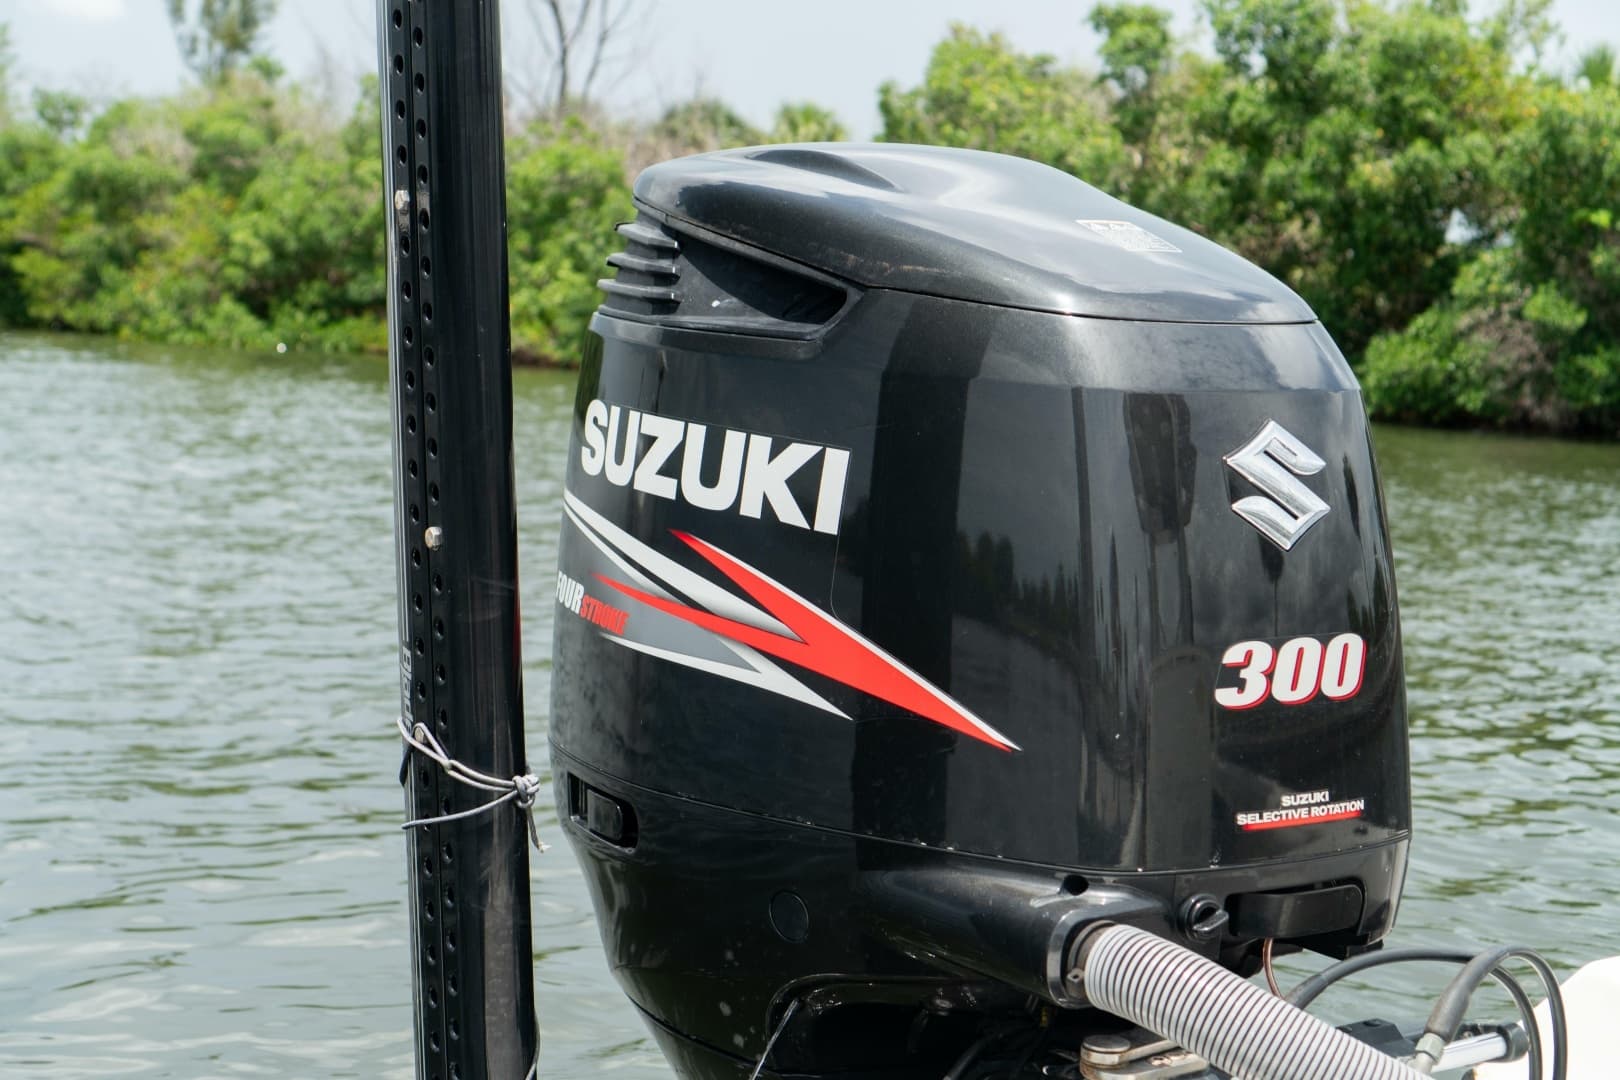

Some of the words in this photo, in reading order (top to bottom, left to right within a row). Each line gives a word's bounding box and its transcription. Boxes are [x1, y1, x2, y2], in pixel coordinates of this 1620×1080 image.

[581, 399, 850, 535] SUZUKI
[1214, 632, 1367, 710] 300
[1236, 808, 1309, 825] SELECTIVE
[1311, 800, 1364, 816] ROTATION
[1281, 791, 1329, 806] SUZUKI
